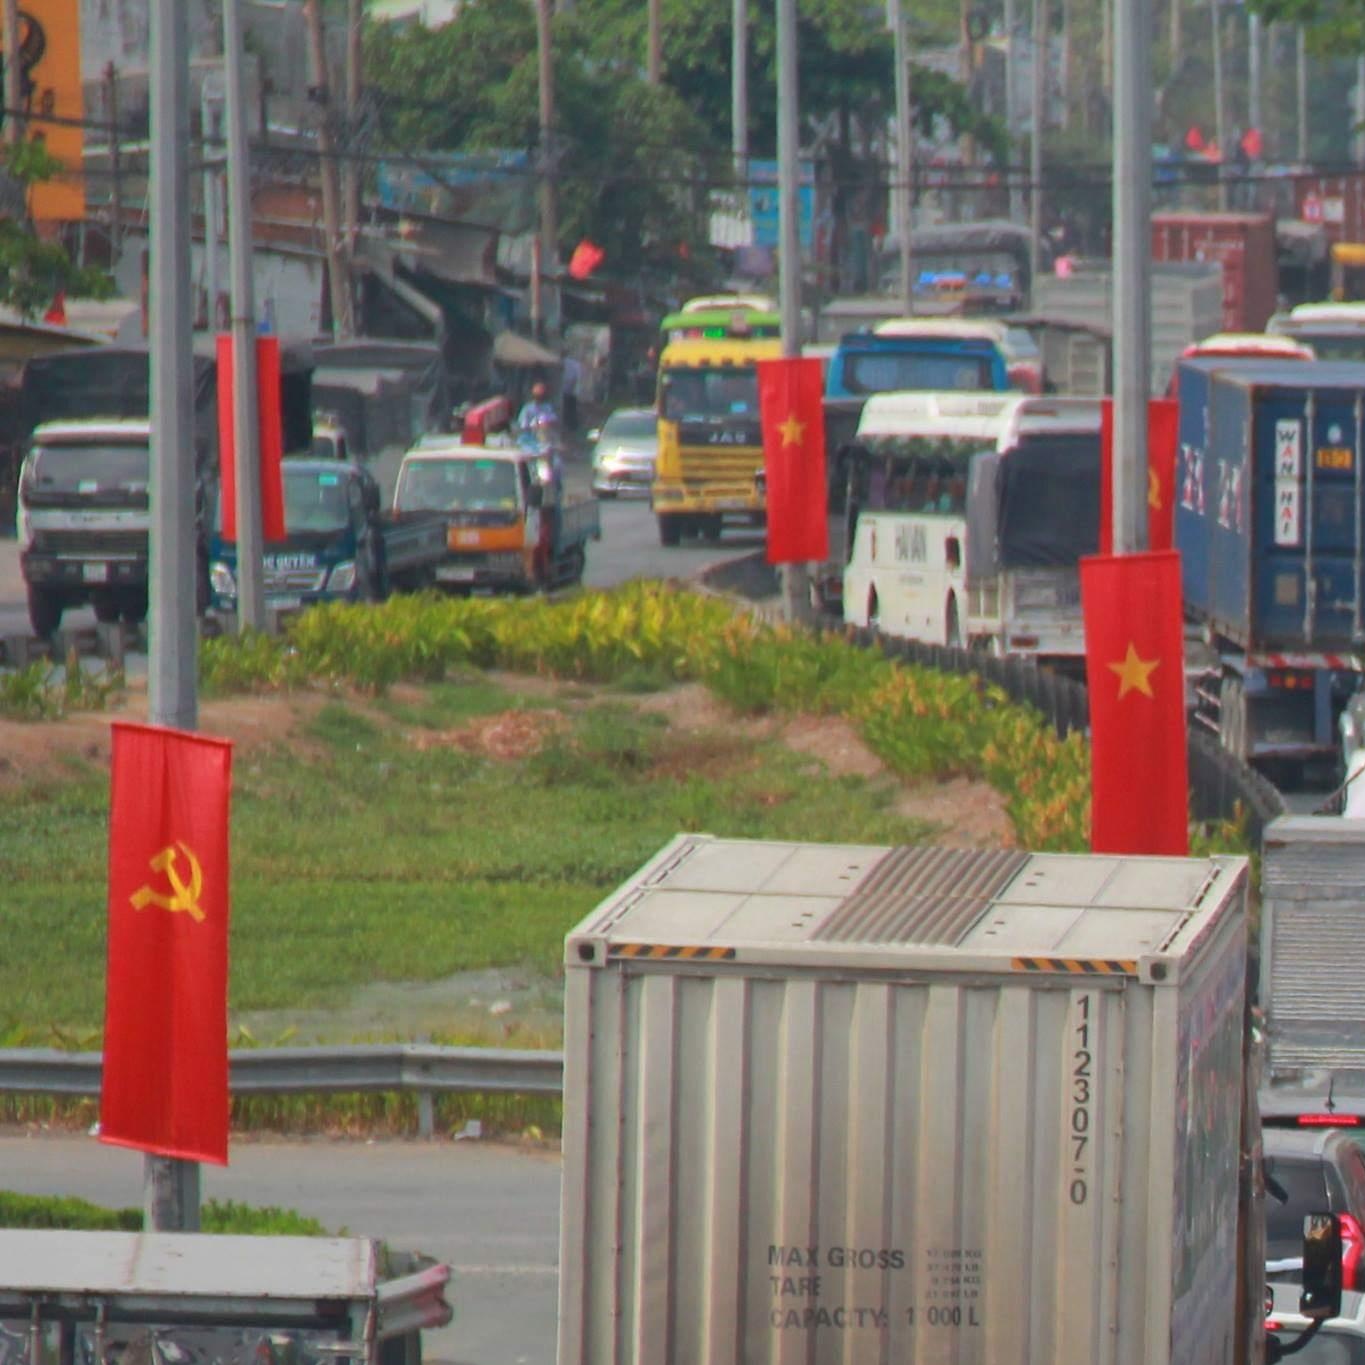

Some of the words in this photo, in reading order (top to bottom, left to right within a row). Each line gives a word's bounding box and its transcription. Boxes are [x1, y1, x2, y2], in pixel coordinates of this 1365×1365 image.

[1278, 430, 1297, 474] WAN
[1280, 491, 1293, 534] HAI
[768, 1245, 820, 1268] MAX
[826, 1246, 906, 1270] GROSS
[770, 1305, 889, 1330] CAPACTY:
